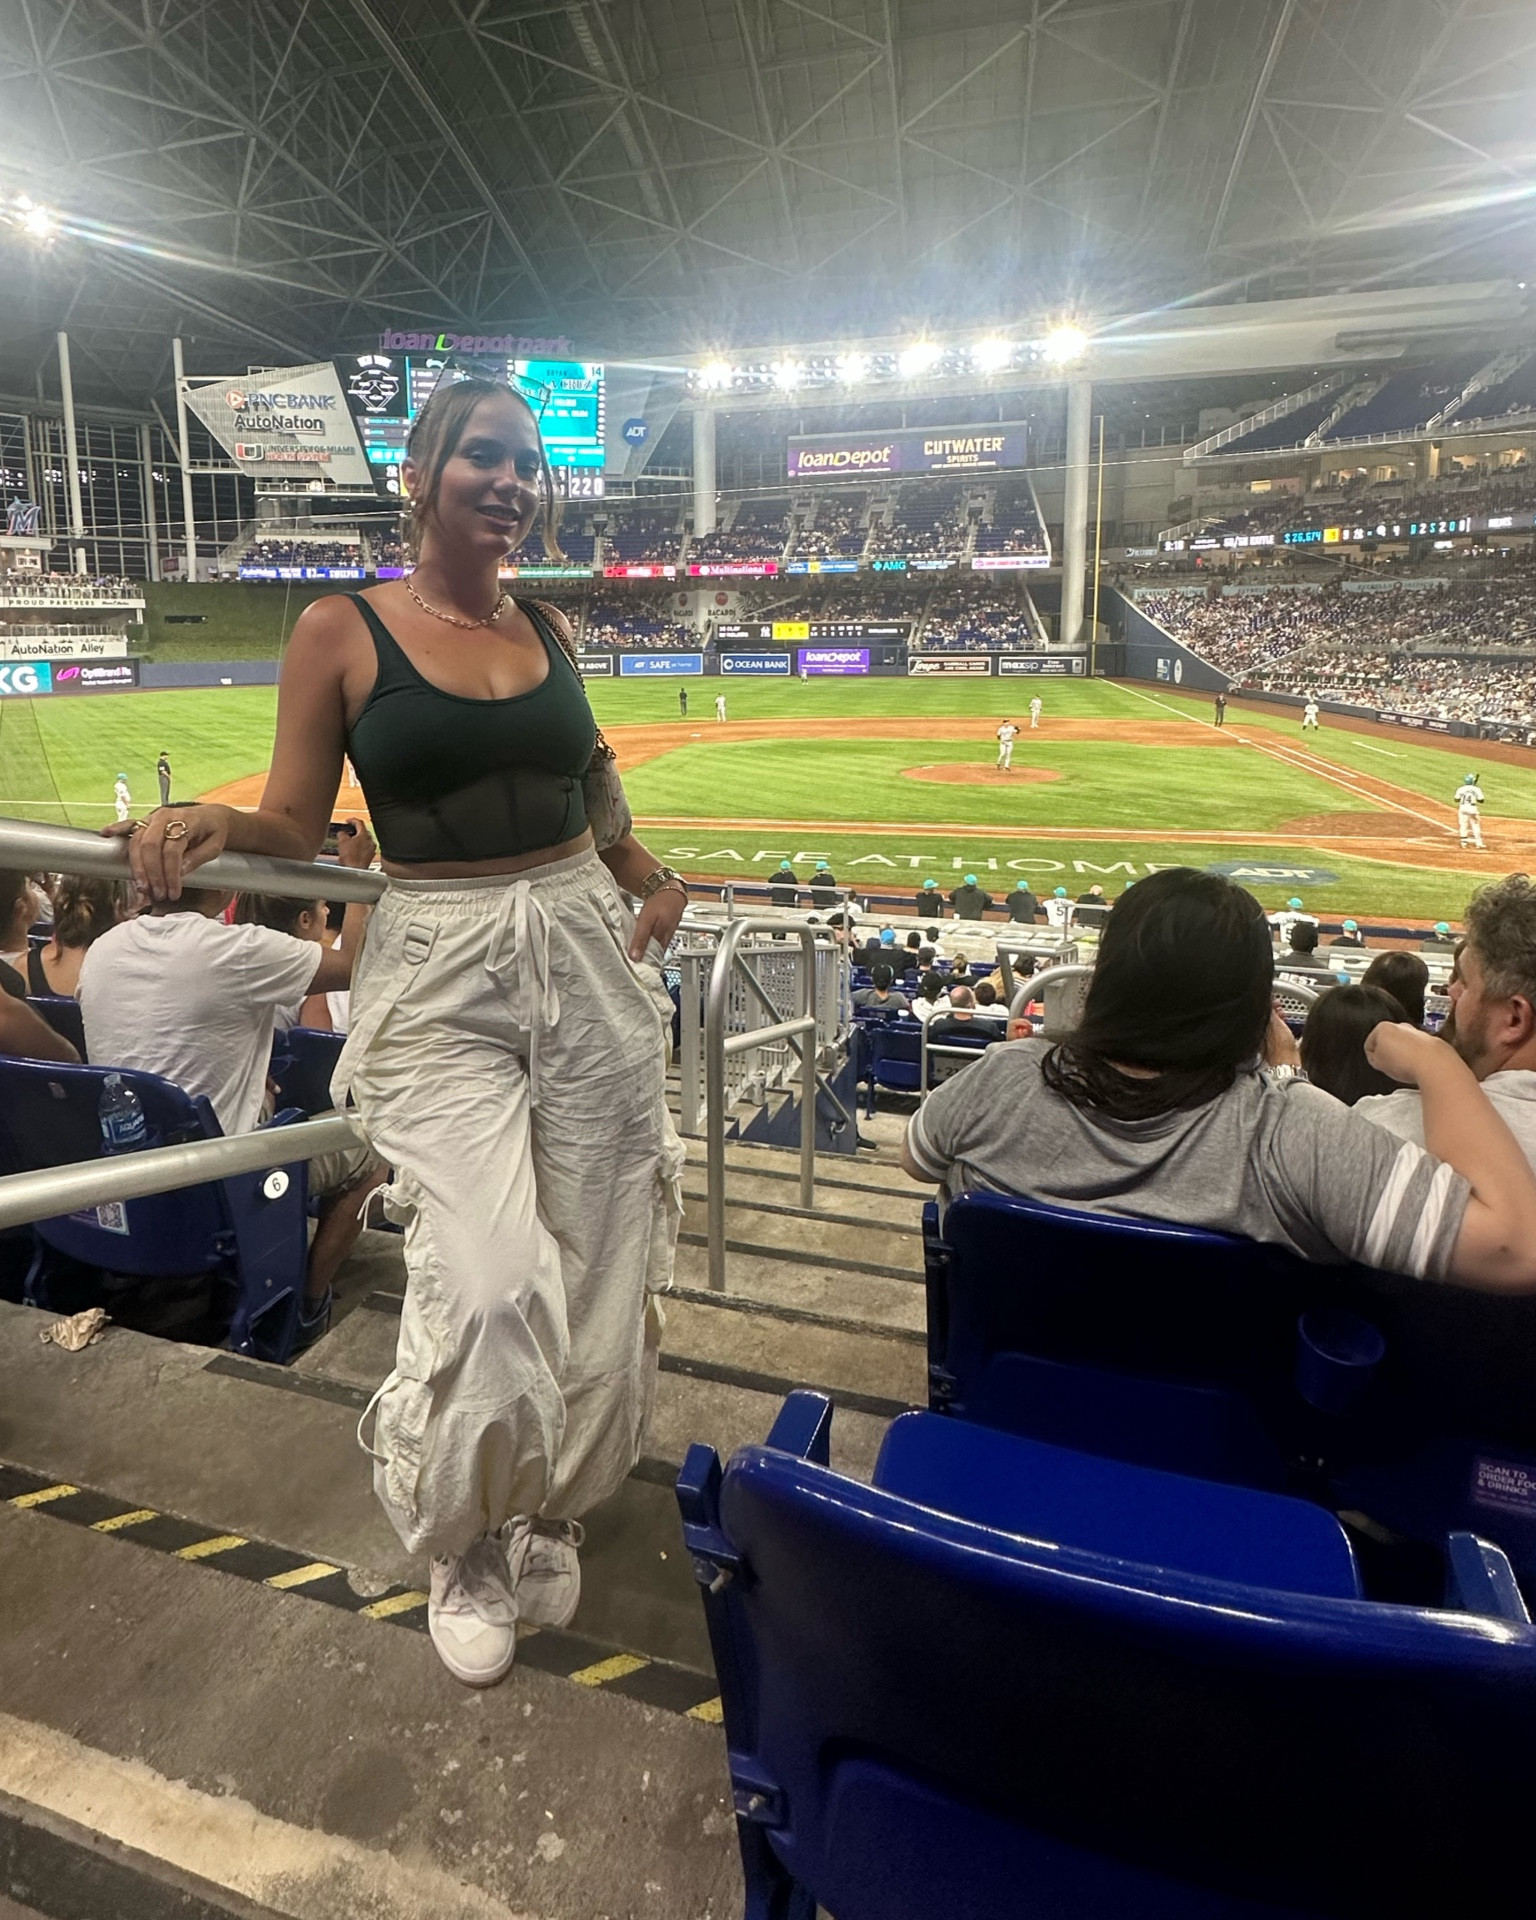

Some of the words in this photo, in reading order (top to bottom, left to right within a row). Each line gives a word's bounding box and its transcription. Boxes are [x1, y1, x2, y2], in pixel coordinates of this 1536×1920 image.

[383, 328, 514, 357] loanDepot
[517, 336, 572, 355] park
[235, 414, 323, 431] AutoNation
[626, 426, 647, 437] ADT
[924, 437, 1002, 455] CUTWATER
[798, 446, 892, 468] loanDepot
[946, 454, 979, 463] SPIRITS
[883, 561, 906, 570] AMG
[707, 609, 736, 617] BACARDI
[11, 644, 73, 655] AutoNation
[81, 643, 104, 655] Alley
[806, 652, 861, 663] loanDepot
[650, 661, 670, 669] SAFE
[735, 660, 762, 669] OCEAN
[764, 660, 787, 669] BANK
[662, 847, 832, 865] SAFE
[846, 854, 937, 868] AT
[1229, 867, 1315, 879] ADT
[272, 1177, 281, 1192] 6
[1480, 1463, 1510, 1476] SCAN
[1512, 1470, 1527, 1480] TO
[1479, 1471, 1515, 1486] ORDER
[1487, 1481, 1528, 1496] DRINKS
